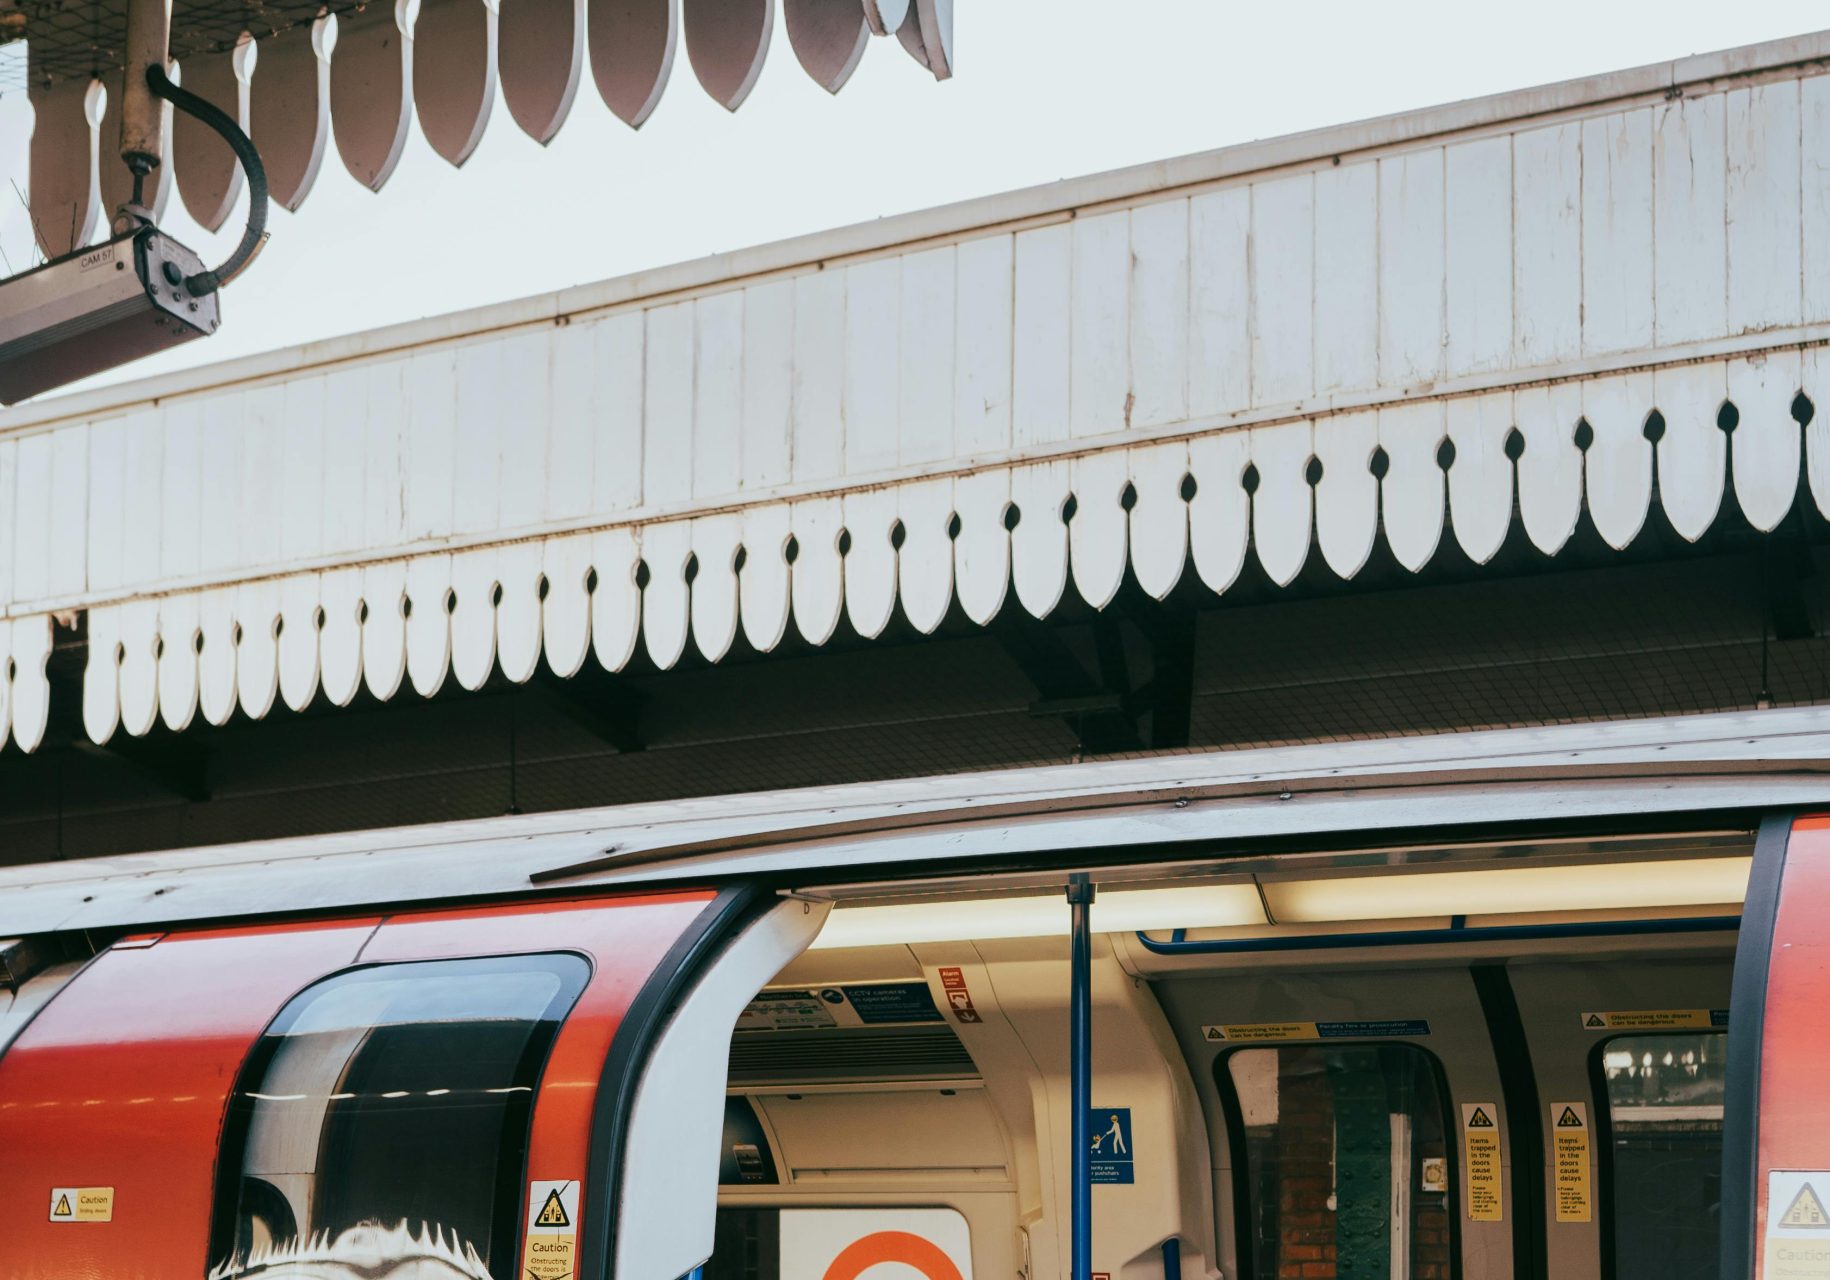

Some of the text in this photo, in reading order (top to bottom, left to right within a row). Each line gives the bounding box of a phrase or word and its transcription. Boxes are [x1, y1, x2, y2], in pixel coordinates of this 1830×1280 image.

[81, 250, 112, 268] CAM 57
[803, 902, 810, 914] D
[80, 1196, 108, 1204] Caution
[532, 1243, 568, 1253] Caution
[530, 1257, 567, 1266] Obstructing
